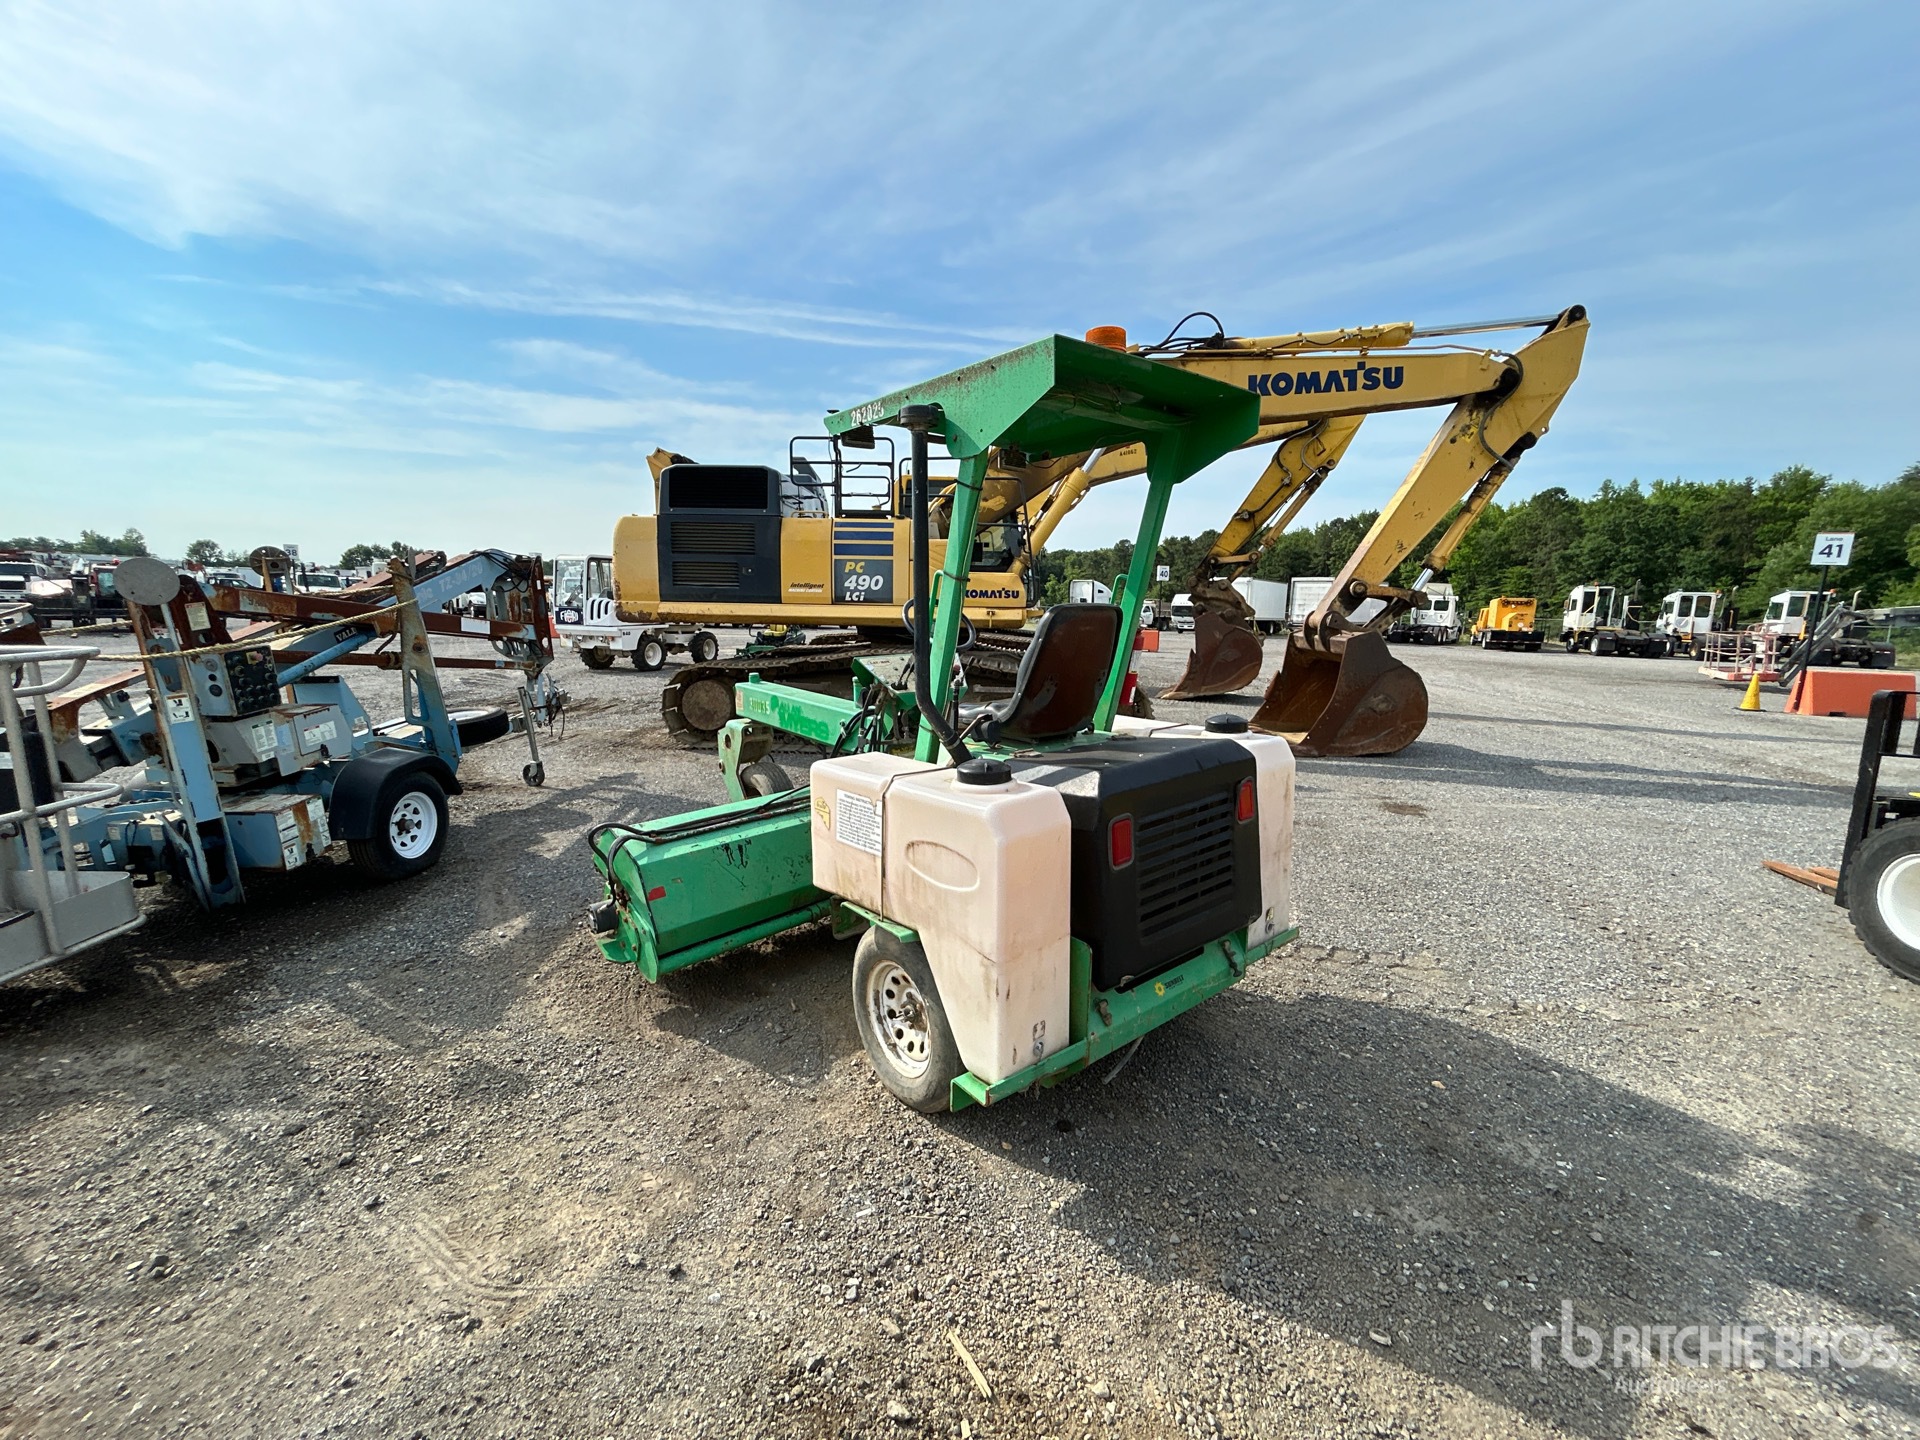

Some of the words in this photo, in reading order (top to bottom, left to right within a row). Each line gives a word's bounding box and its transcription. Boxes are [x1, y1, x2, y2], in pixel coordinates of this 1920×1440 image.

[1247, 361, 1404, 397] KOMATSU
[285, 549, 298, 557] 38
[1818, 543, 1844, 558] 41
[844, 561, 865, 574] PC
[1159, 570, 1169, 578] 40
[843, 574, 884, 591] 490
